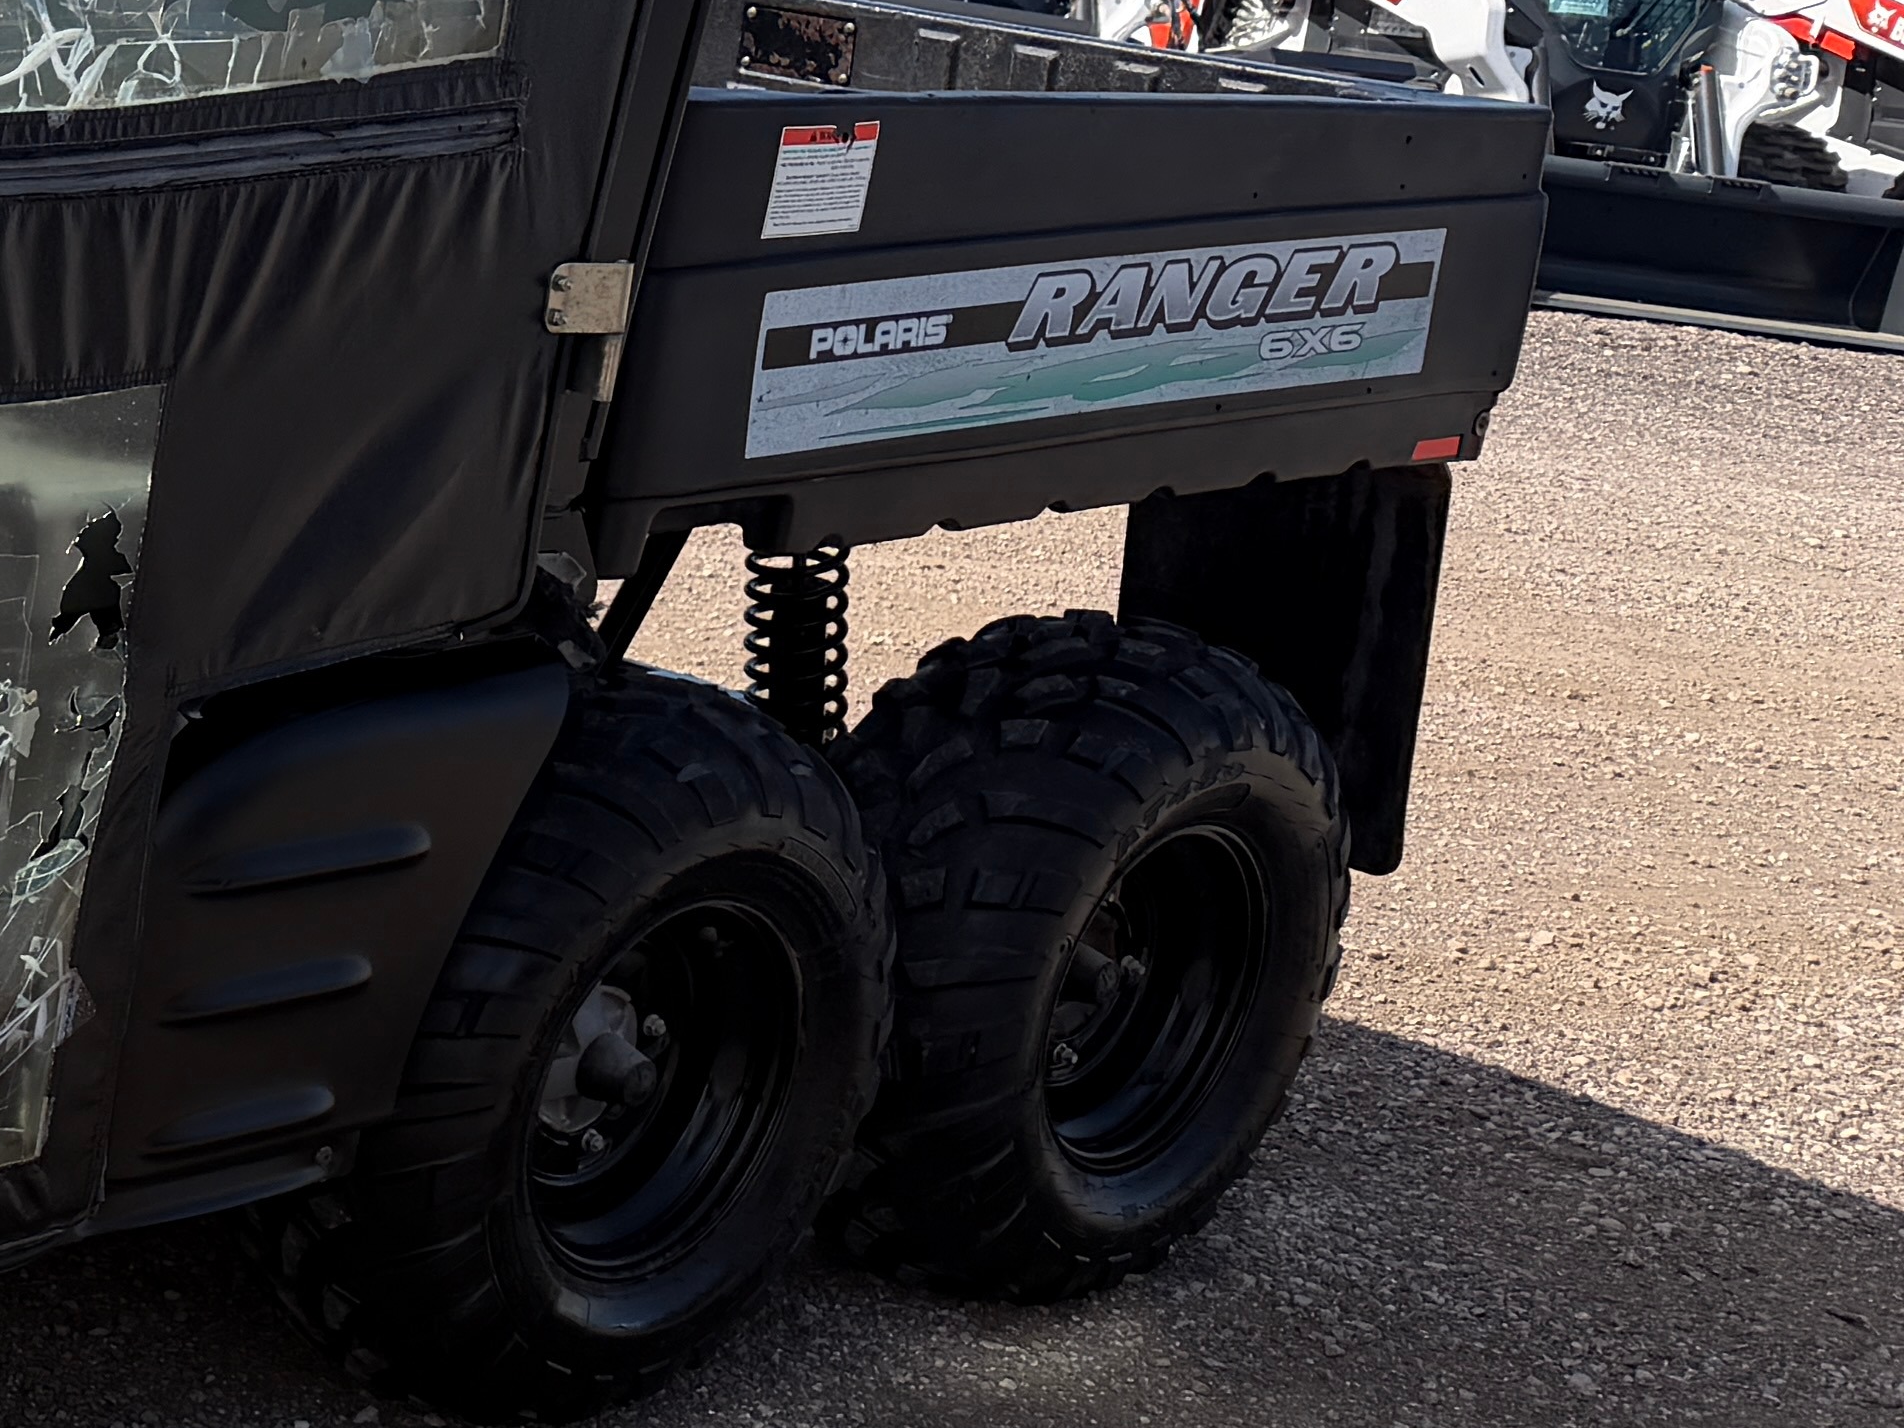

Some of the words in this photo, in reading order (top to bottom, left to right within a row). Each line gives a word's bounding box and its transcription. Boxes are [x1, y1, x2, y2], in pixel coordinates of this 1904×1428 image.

[809, 314, 952, 360] POLARIS
[1006, 242, 1399, 352] RANGER
[1258, 322, 1367, 361] 6X6
